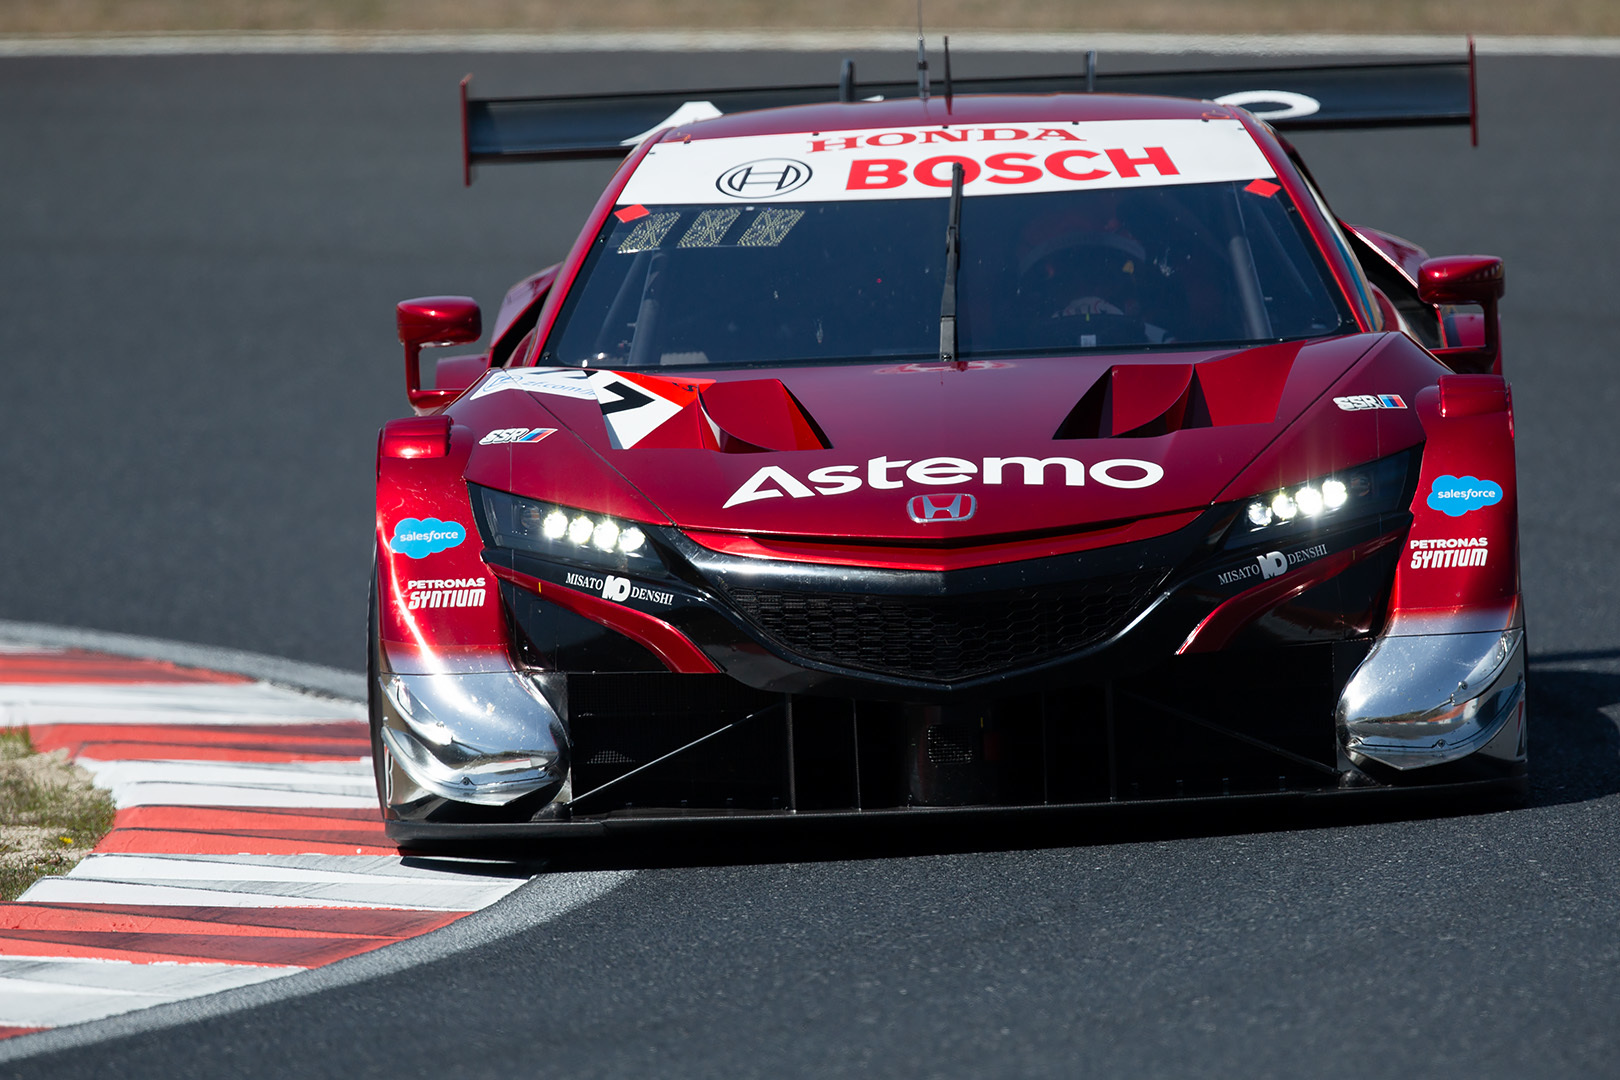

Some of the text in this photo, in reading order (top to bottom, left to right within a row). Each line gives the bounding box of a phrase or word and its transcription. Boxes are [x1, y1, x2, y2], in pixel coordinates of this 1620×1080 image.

[806, 128, 1087, 153] HONDA
[845, 147, 1181, 190] BOSCH
[1333, 395, 1384, 411] SSR
[479, 428, 530, 445] SSR
[722, 455, 1164, 509] Astemo
[1438, 488, 1495, 500] salesforce
[400, 530, 458, 543] salesforce
[1410, 537, 1488, 549] PETRONAS
[1218, 564, 1260, 585] MISATO
[1287, 544, 1328, 565] DENSHI
[1411, 548, 1488, 569] SYNTIUM
[408, 577, 486, 590] PETRONAS
[565, 573, 604, 590] MISATO
[630, 586, 674, 606] DENSHI
[408, 588, 486, 610] SYNTIUM
